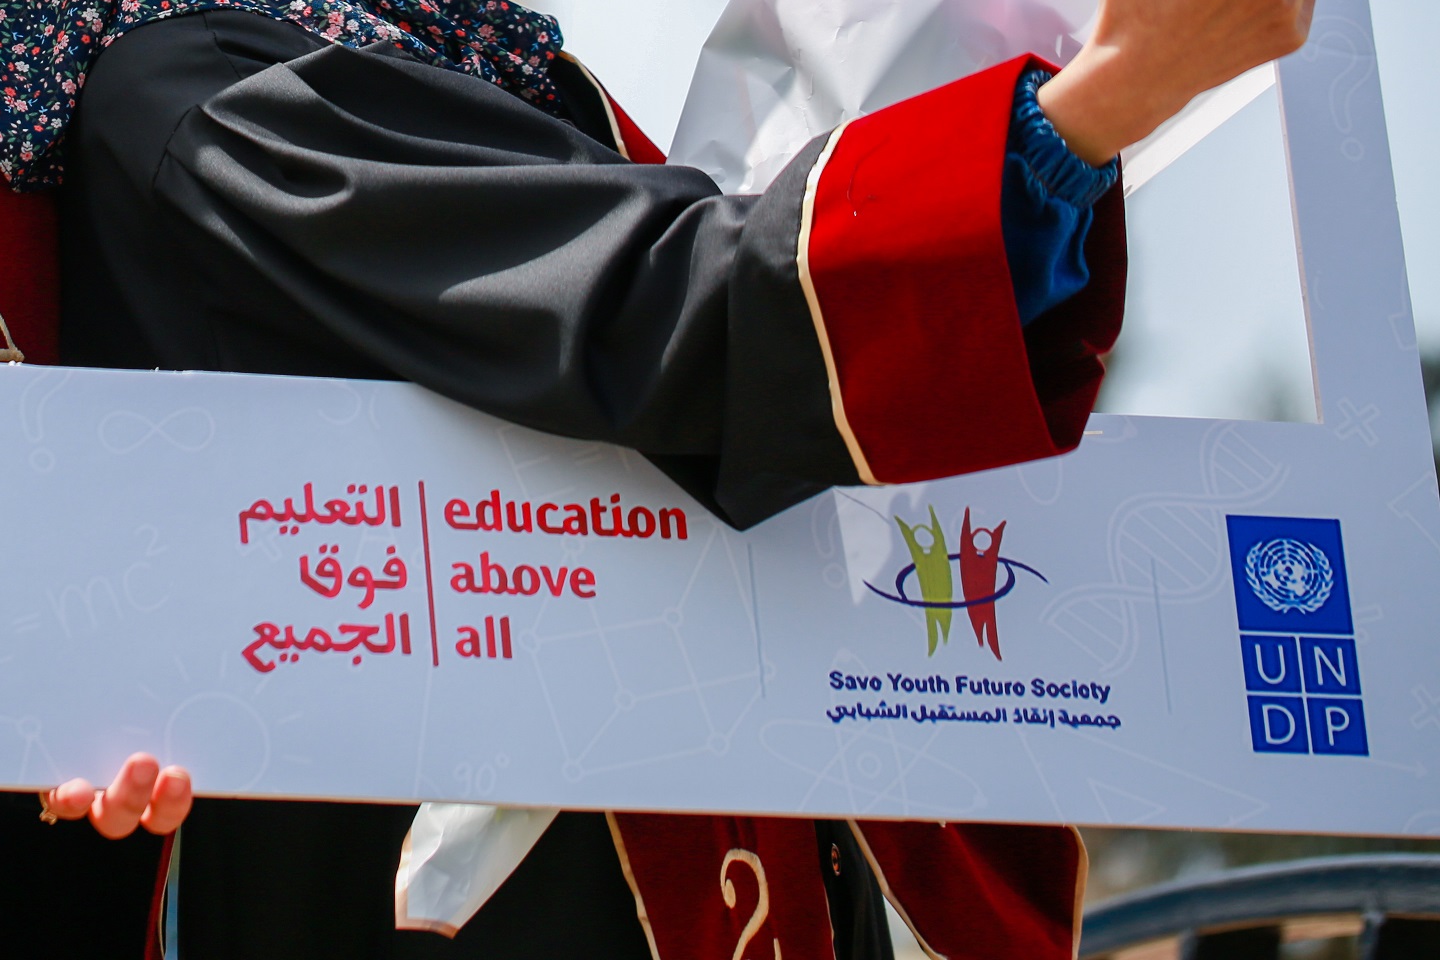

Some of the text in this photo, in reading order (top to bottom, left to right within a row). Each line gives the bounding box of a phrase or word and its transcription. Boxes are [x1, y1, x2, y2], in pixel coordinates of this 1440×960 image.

[239, 482, 401, 543] التعليم
[444, 489, 688, 540] education
[299, 544, 408, 610] فوق
[450, 551, 596, 599] above
[241, 613, 411, 673] الجميع
[455, 616, 512, 659] all
[828, 670, 1112, 705] Save Youth Future Society
[910, 704, 1008, 725] المستقبل
